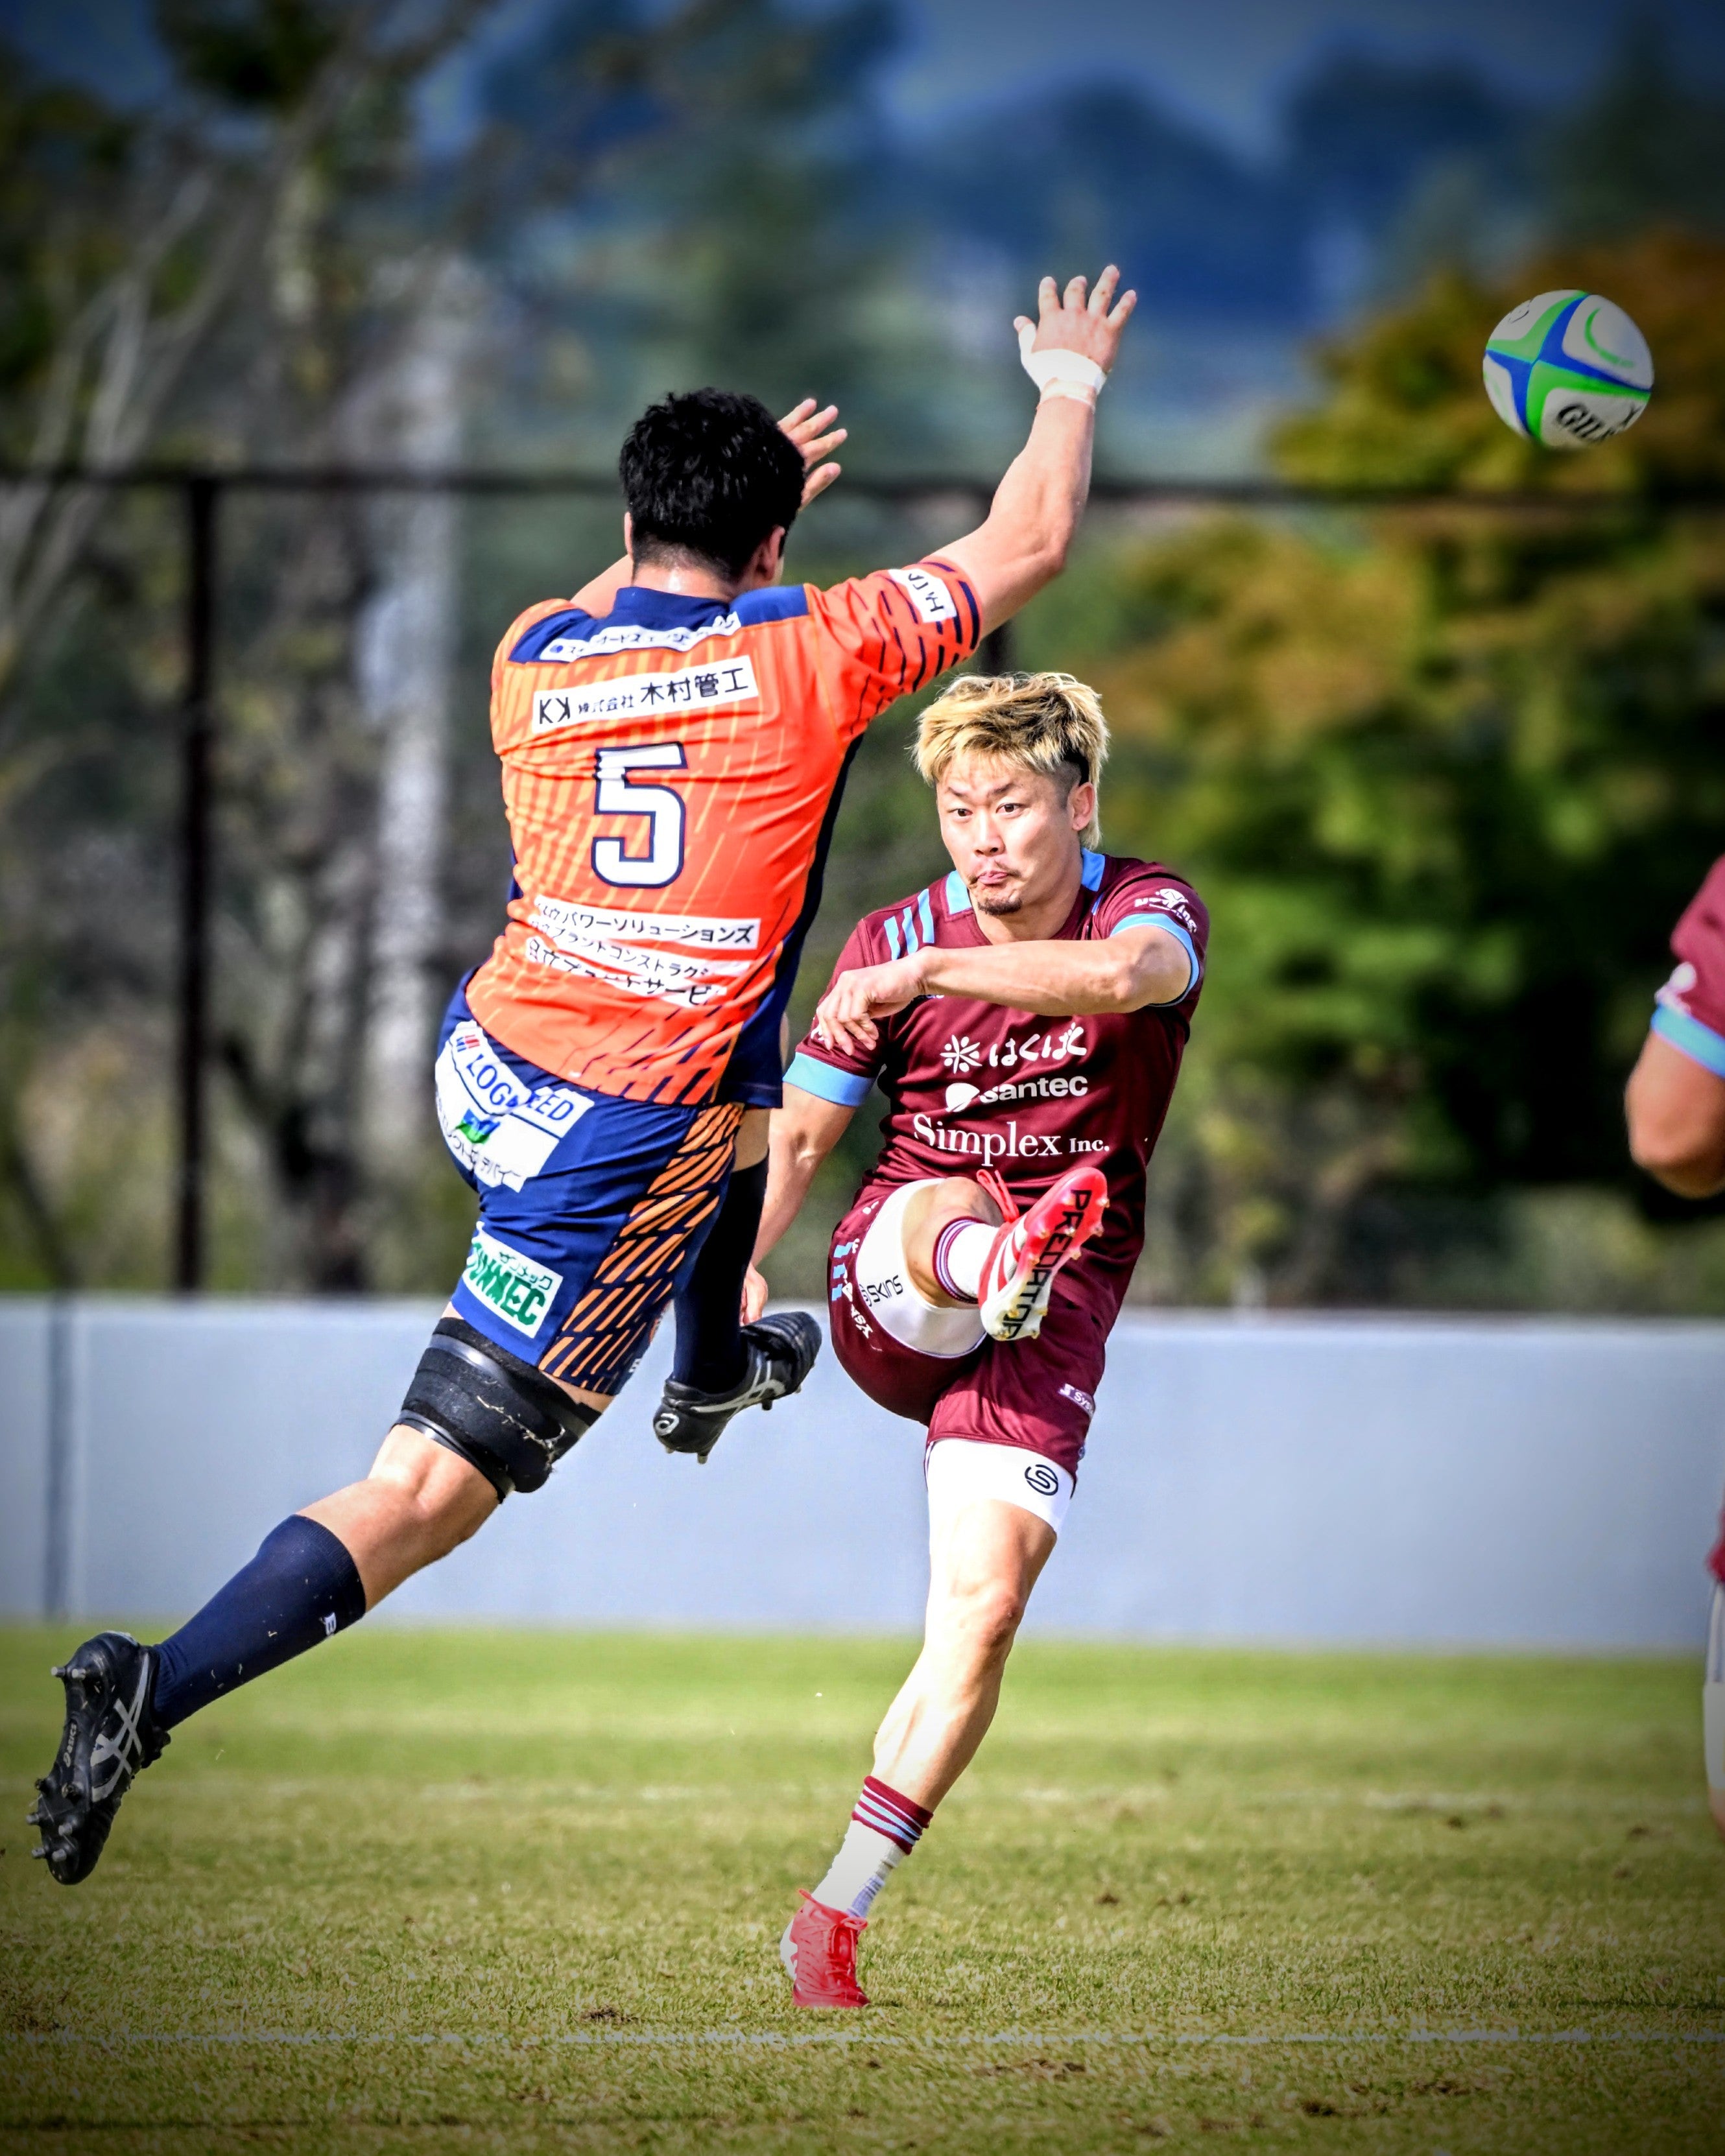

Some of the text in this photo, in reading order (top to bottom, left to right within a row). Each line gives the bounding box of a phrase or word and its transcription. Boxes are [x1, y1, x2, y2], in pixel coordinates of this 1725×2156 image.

[641, 668, 748, 705] 木村管工
[591, 741, 688, 889] 5
[979, 1076, 1088, 1103] santec
[913, 1113, 1110, 1167] Simplex Inc.
